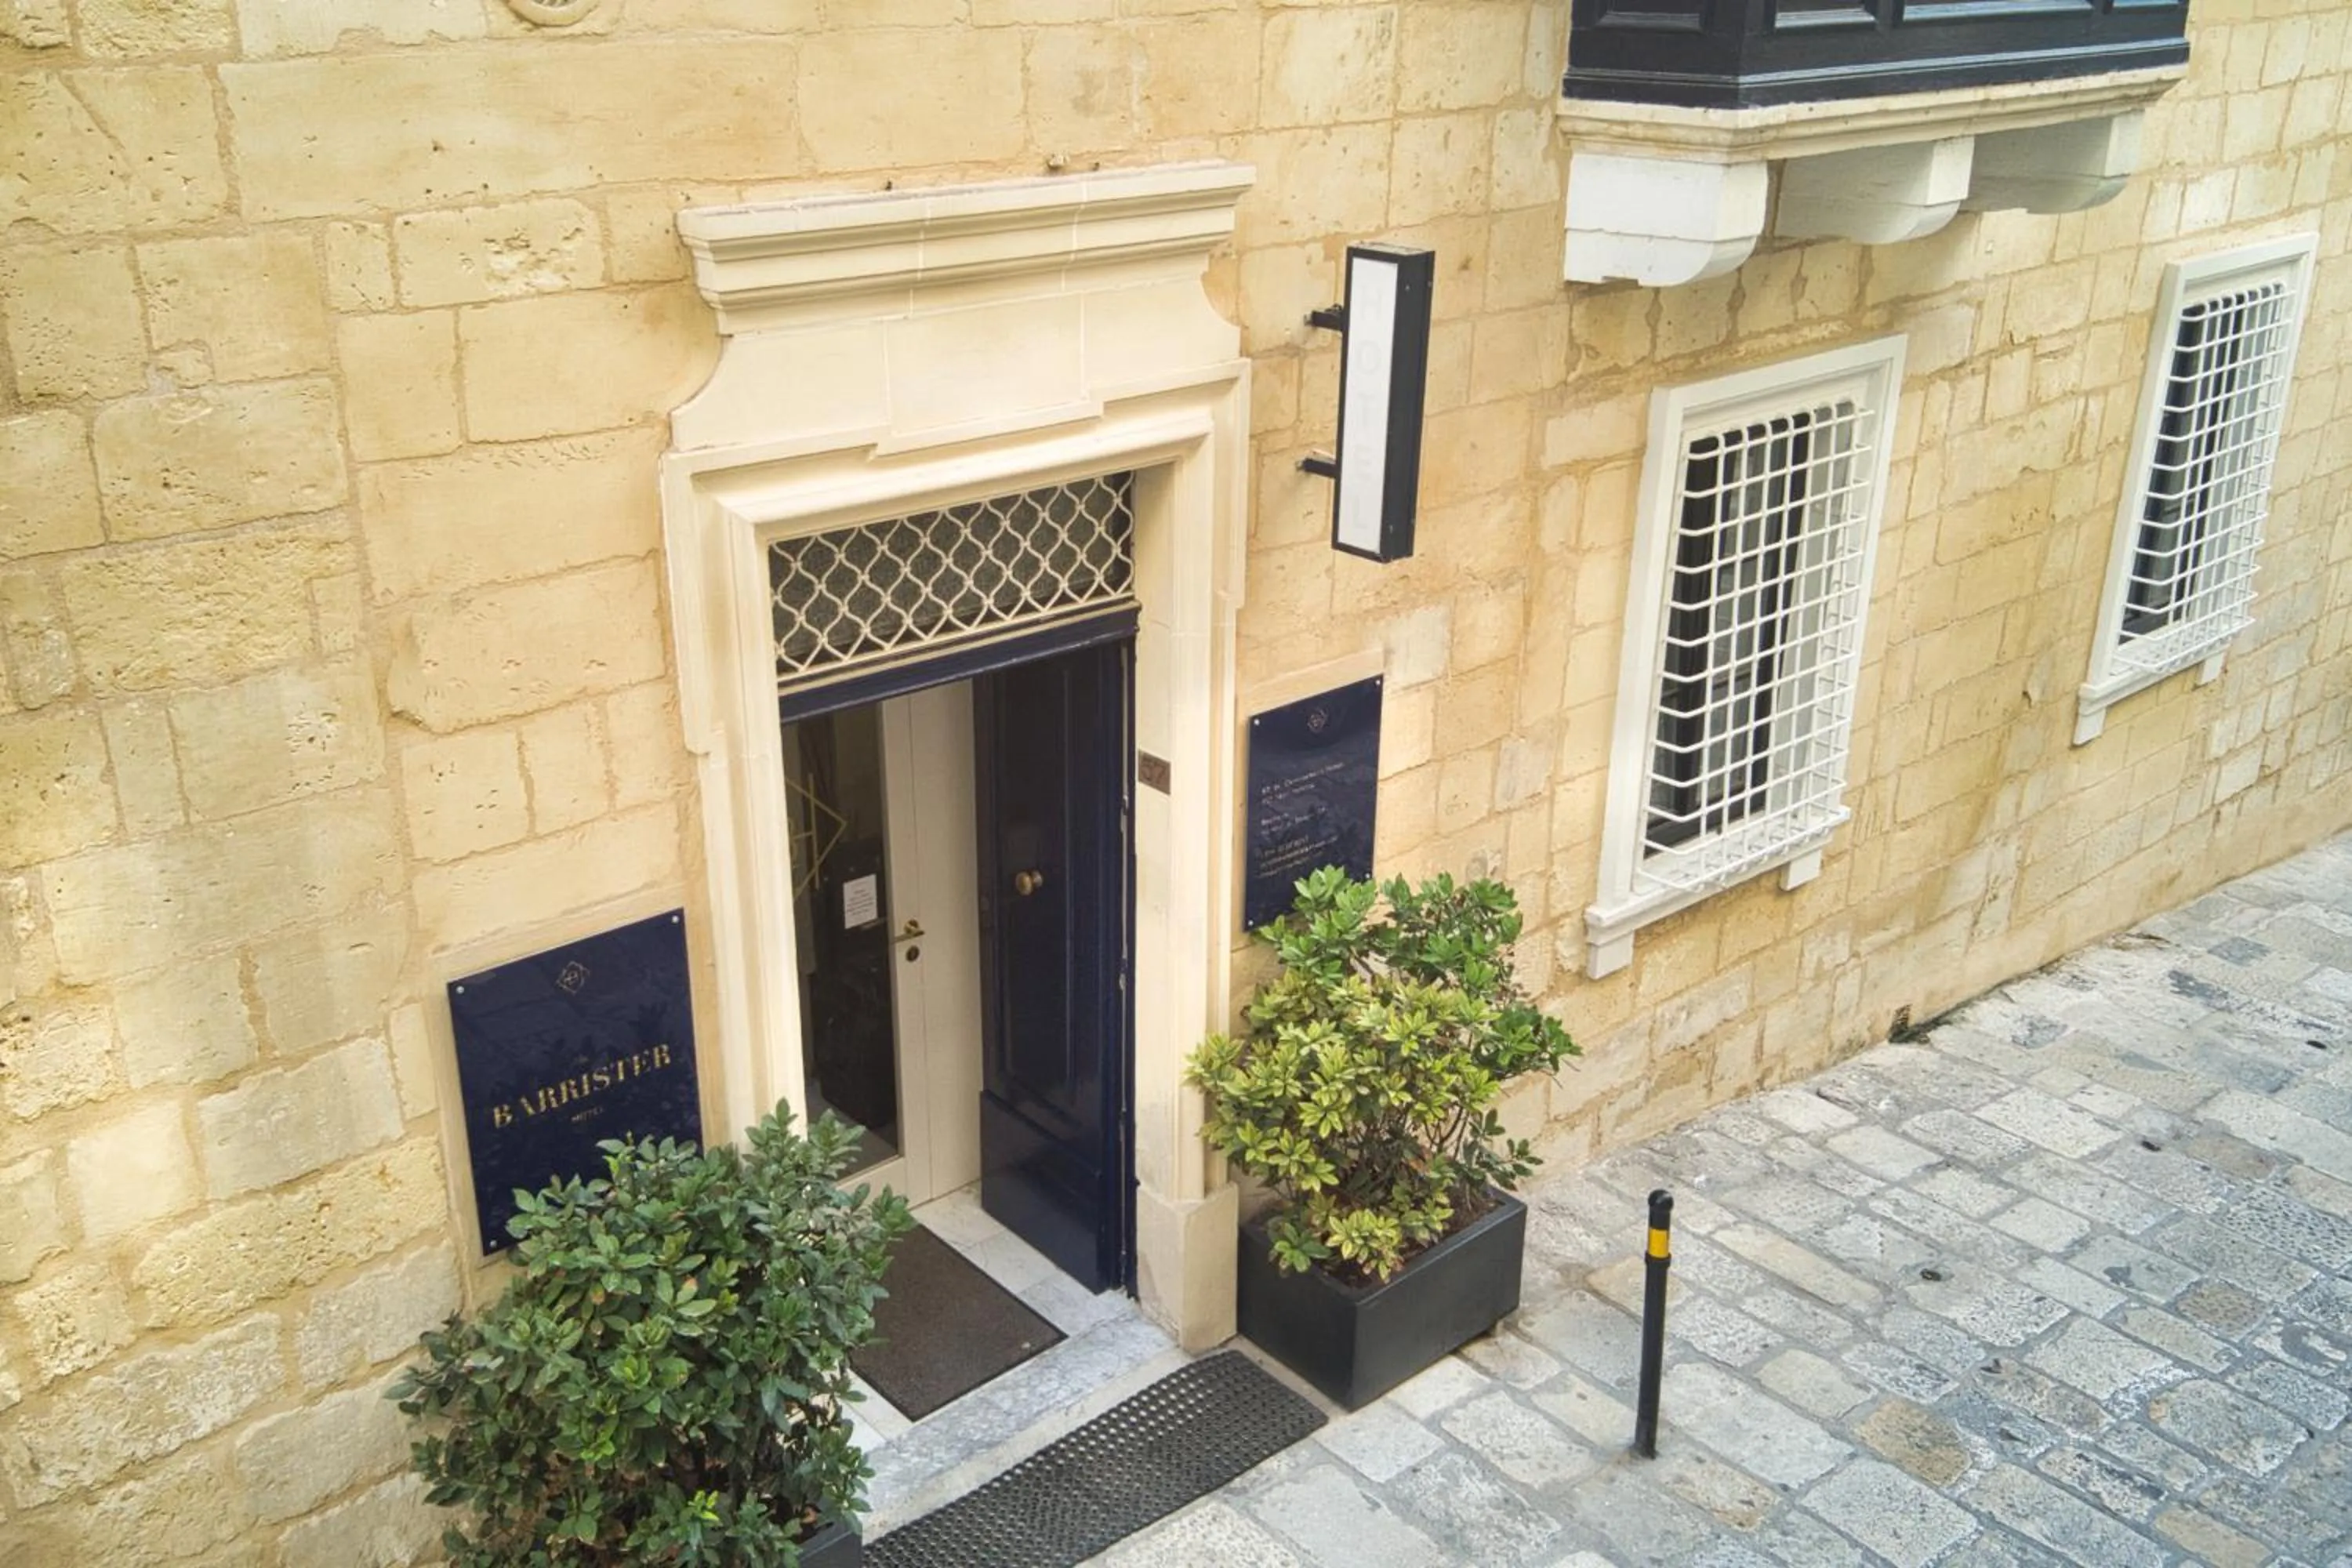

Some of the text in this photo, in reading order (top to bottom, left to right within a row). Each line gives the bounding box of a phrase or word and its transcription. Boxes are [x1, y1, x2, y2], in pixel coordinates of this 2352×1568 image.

[1352, 285, 1383, 530] HOTEL
[1141, 756, 1166, 784] 57
[493, 1044, 671, 1129] BARRISTER
